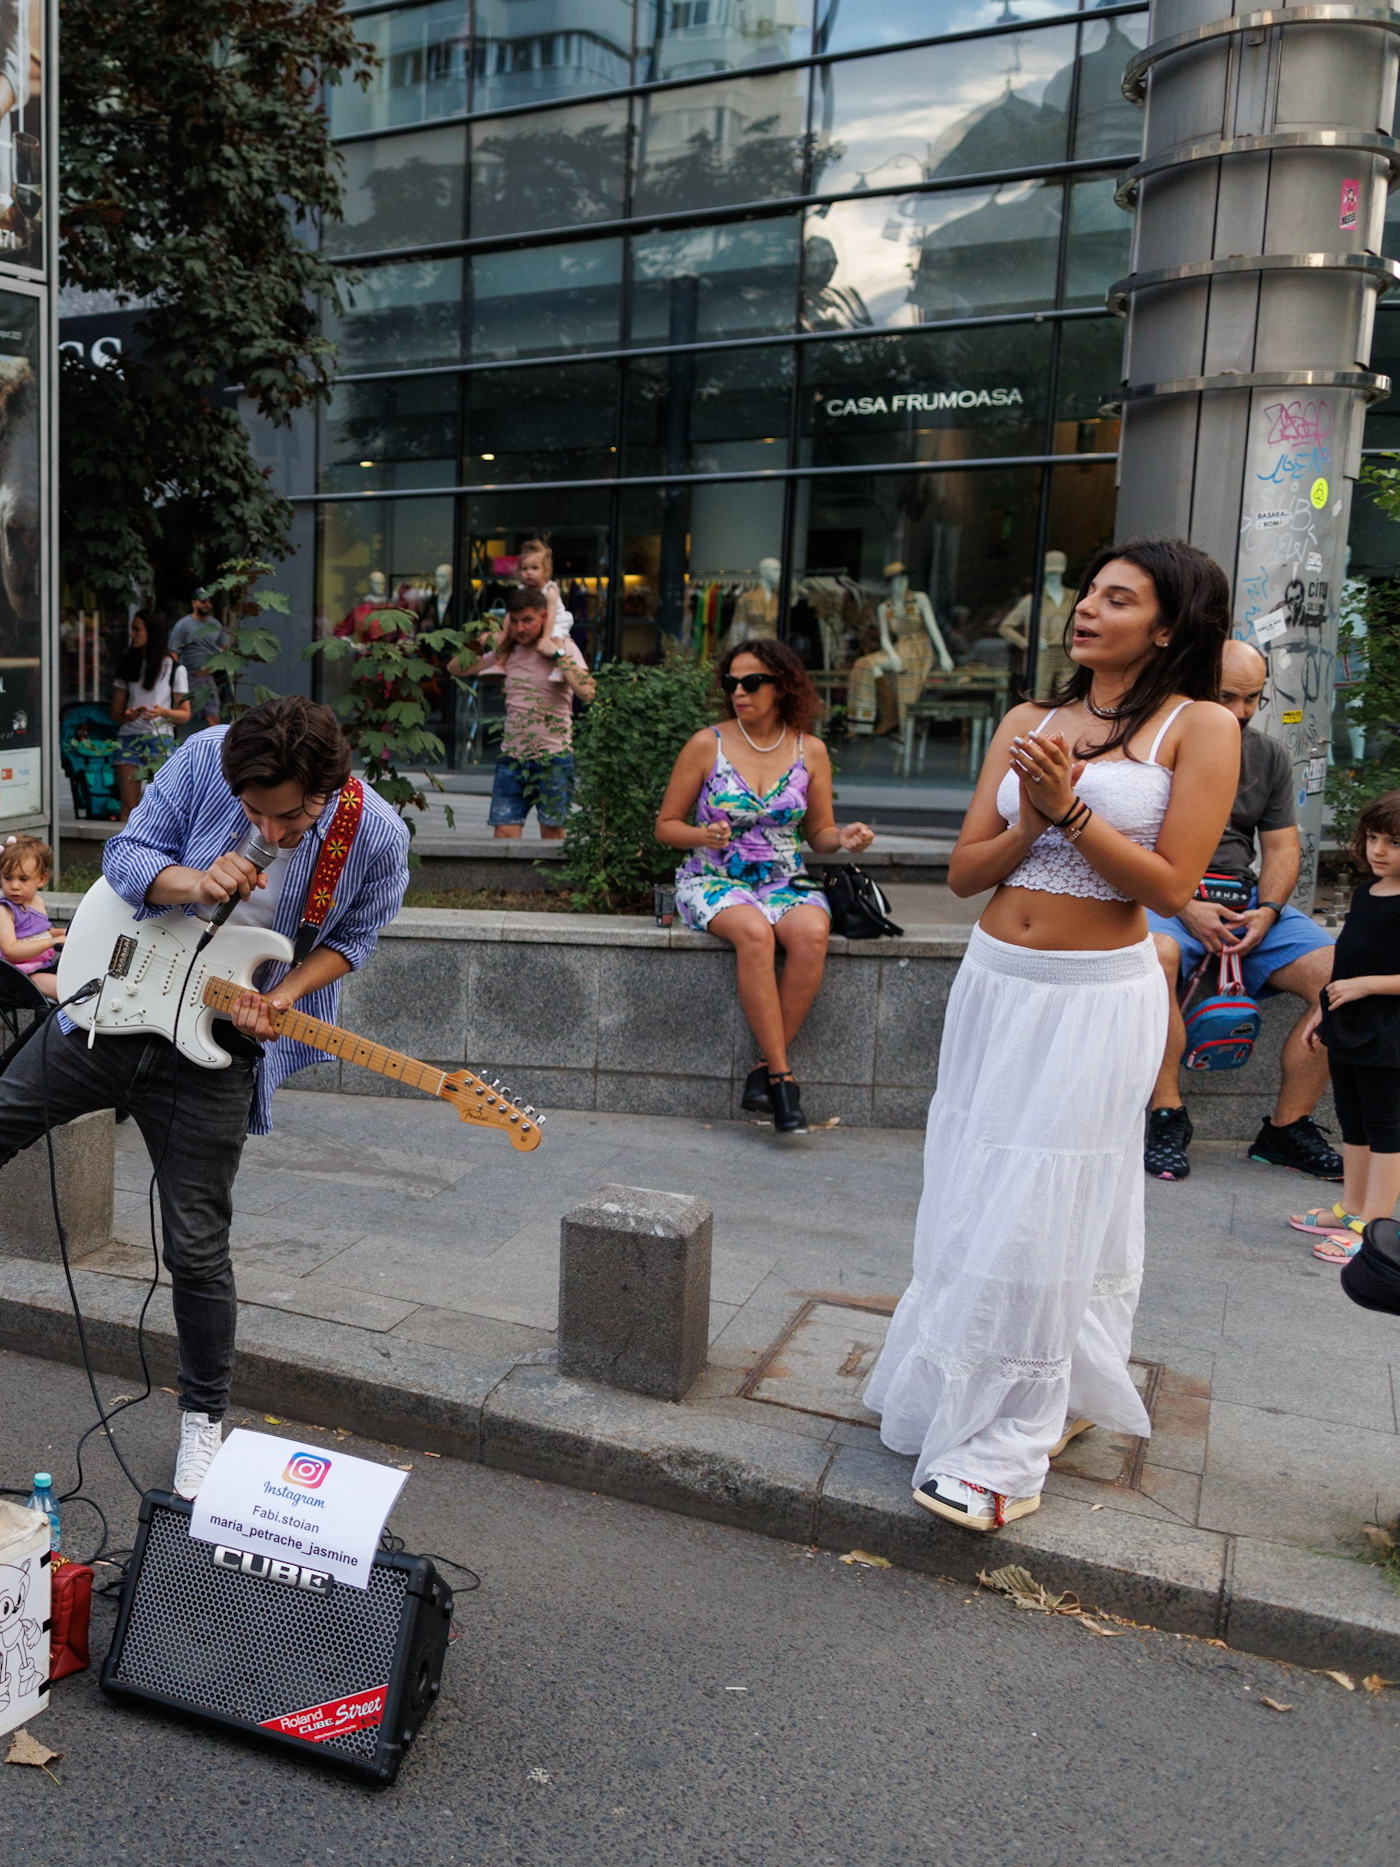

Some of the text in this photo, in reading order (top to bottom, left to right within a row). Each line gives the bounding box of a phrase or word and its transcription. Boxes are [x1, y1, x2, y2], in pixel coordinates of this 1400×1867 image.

[826, 388, 1023, 417] CASA FRUMOASA
[1257, 511, 1289, 519] BASARA
[263, 1481, 325, 1509] Instagram
[252, 1505, 320, 1533] Fabi.stoian
[210, 1515, 358, 1566] maria_petrache_jasmine
[213, 1545, 330, 1594] CUBE
[280, 1708, 323, 1730] Roland
[299, 1696, 383, 1734] CUBE Street
[361, 1714, 379, 1725] EX
